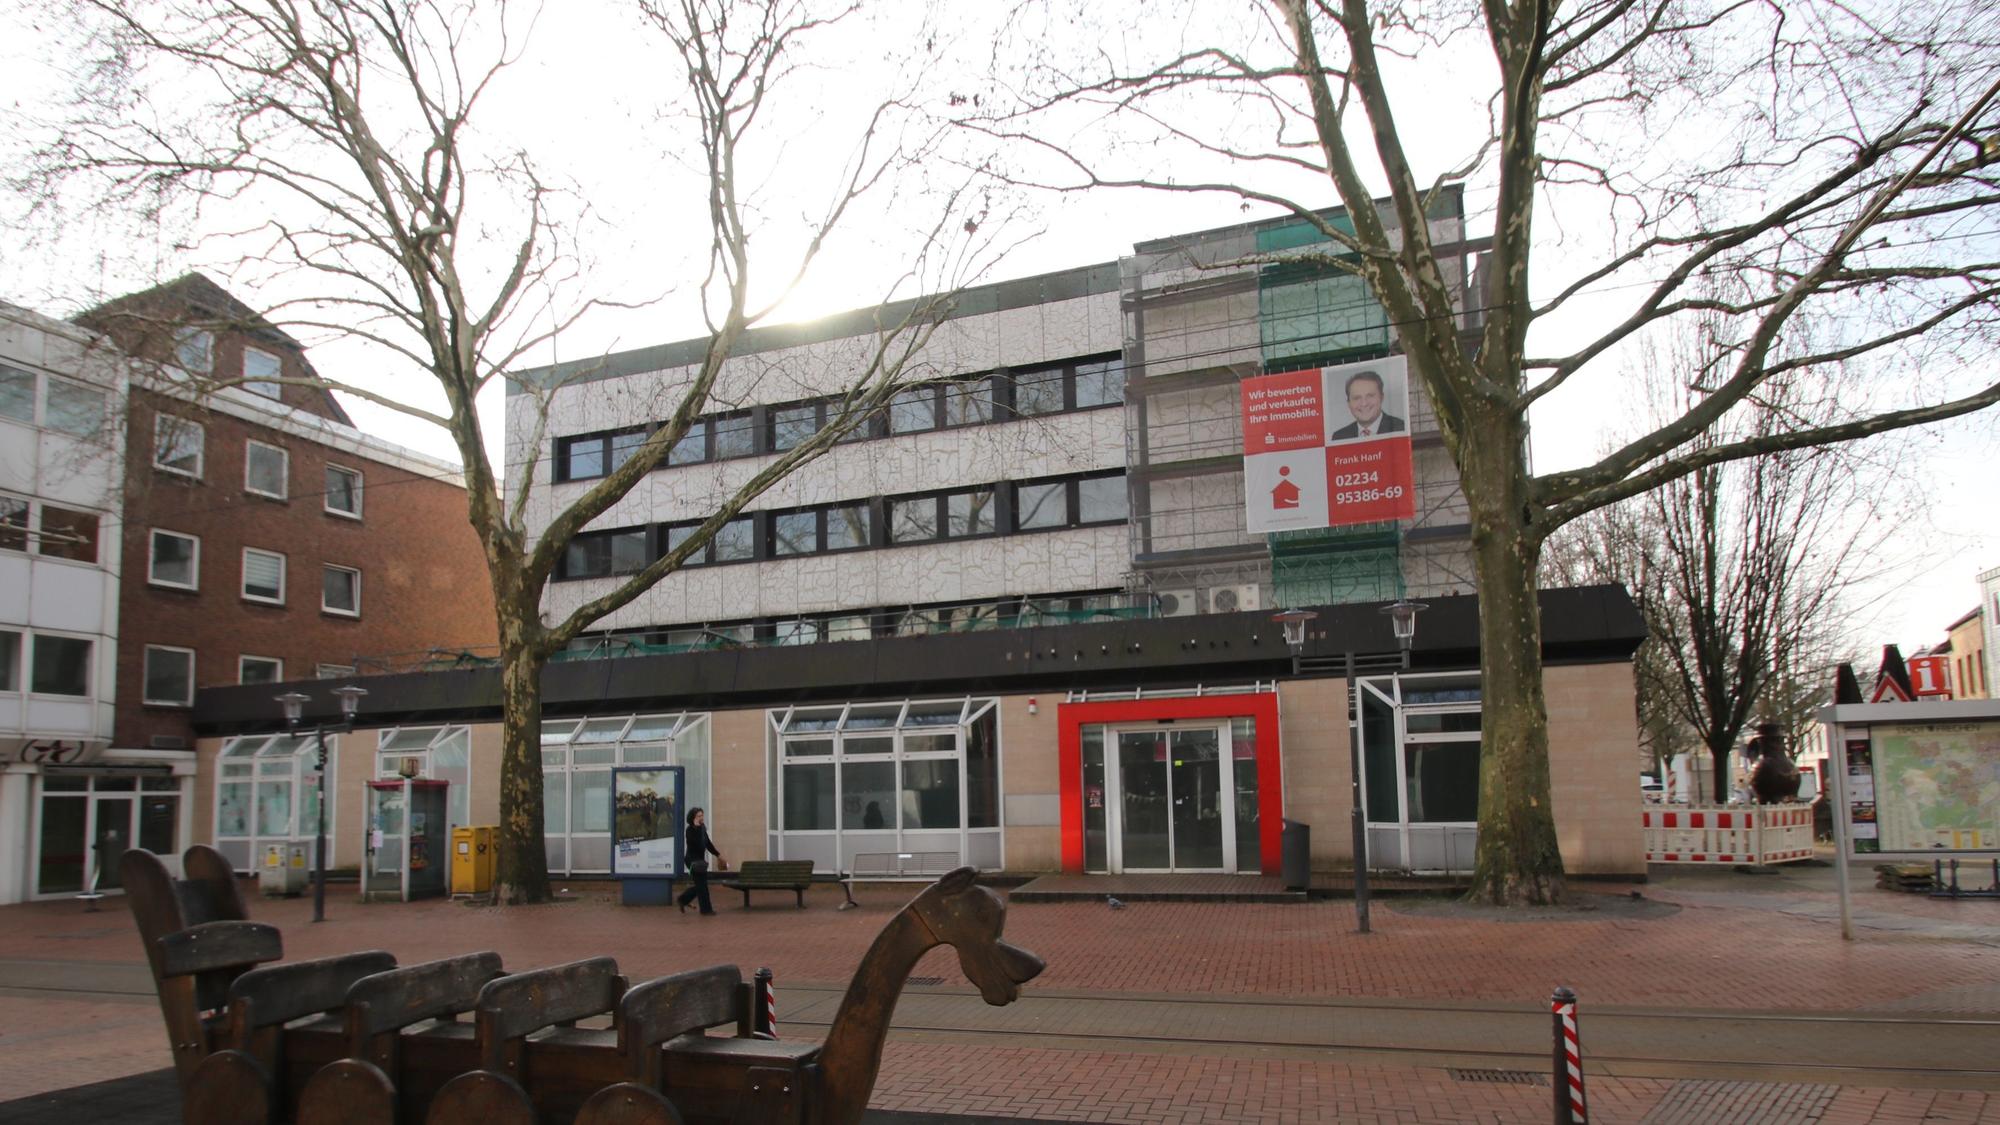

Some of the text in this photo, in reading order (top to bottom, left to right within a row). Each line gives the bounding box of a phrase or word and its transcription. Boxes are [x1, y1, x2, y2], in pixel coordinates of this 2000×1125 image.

[1249, 385, 1312, 400] Wir bewerten
[1249, 396, 1316, 412] und verkaufen
[1250, 408, 1320, 424] Ihre Immobilie.
[1278, 433, 1317, 443] Immobilien
[1334, 451, 1382, 465] Frank Hanf
[1335, 471, 1379, 487] 02234
[1336, 485, 1403, 504] 95386-69
